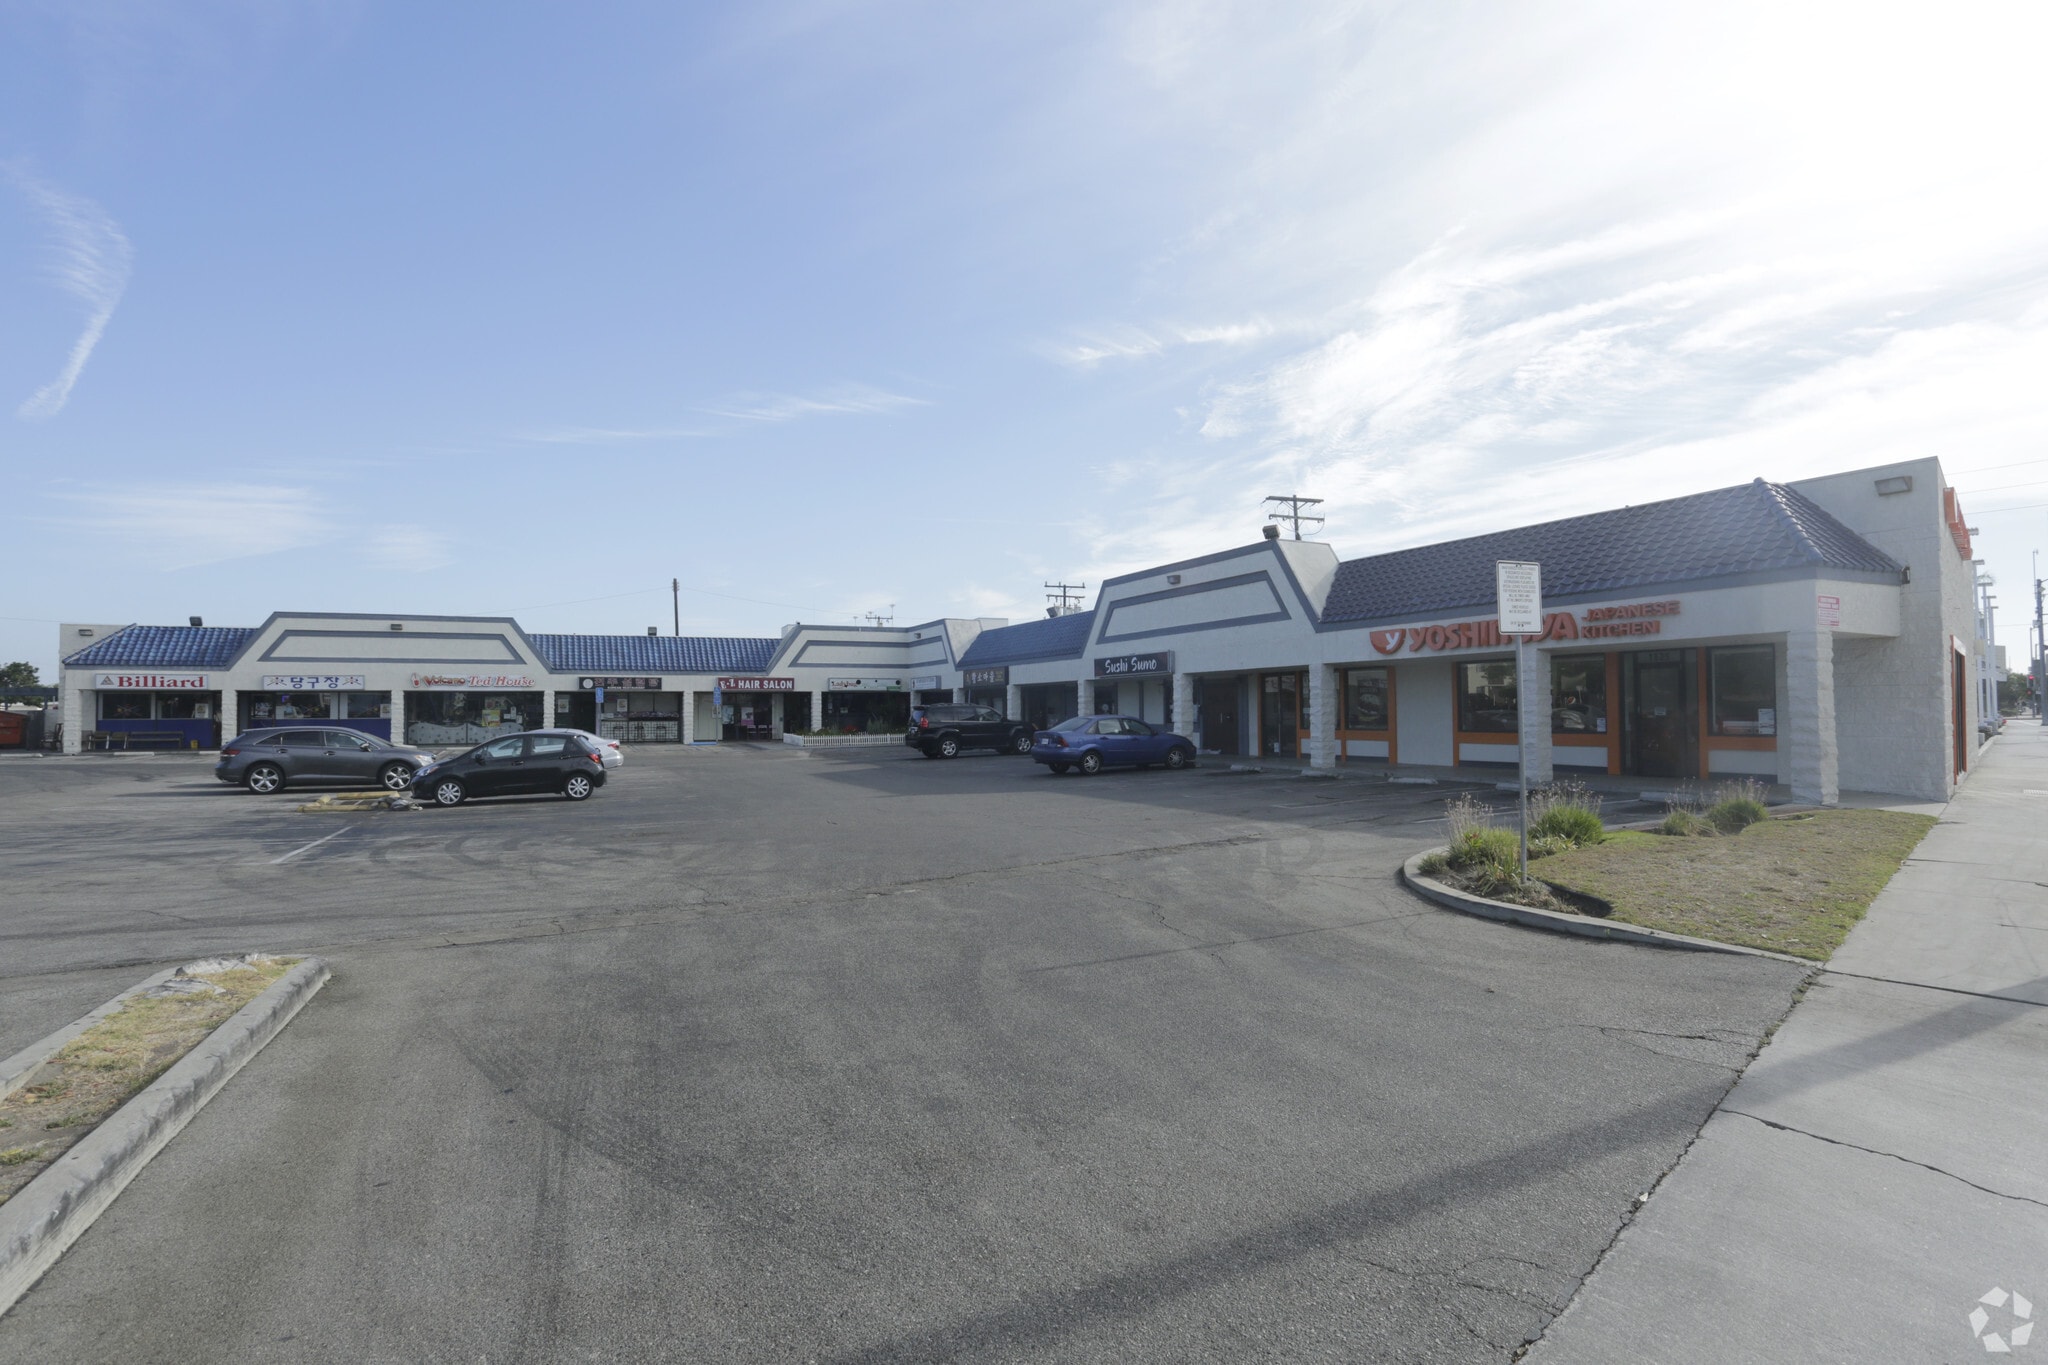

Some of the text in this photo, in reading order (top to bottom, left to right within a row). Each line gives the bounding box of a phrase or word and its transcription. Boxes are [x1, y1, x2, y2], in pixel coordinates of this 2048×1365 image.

[1581, 600, 1680, 622] JAPANESE
[1581, 620, 1661, 639] KITCHEN
[1105, 656, 1157, 674] Sushi Sumo
[117, 675, 204, 688] Billiard
[290, 676, 340, 689] 당구장
[494, 675, 535, 688] House
[738, 679, 760, 689] HAIR
[763, 680, 793, 689] SALON
